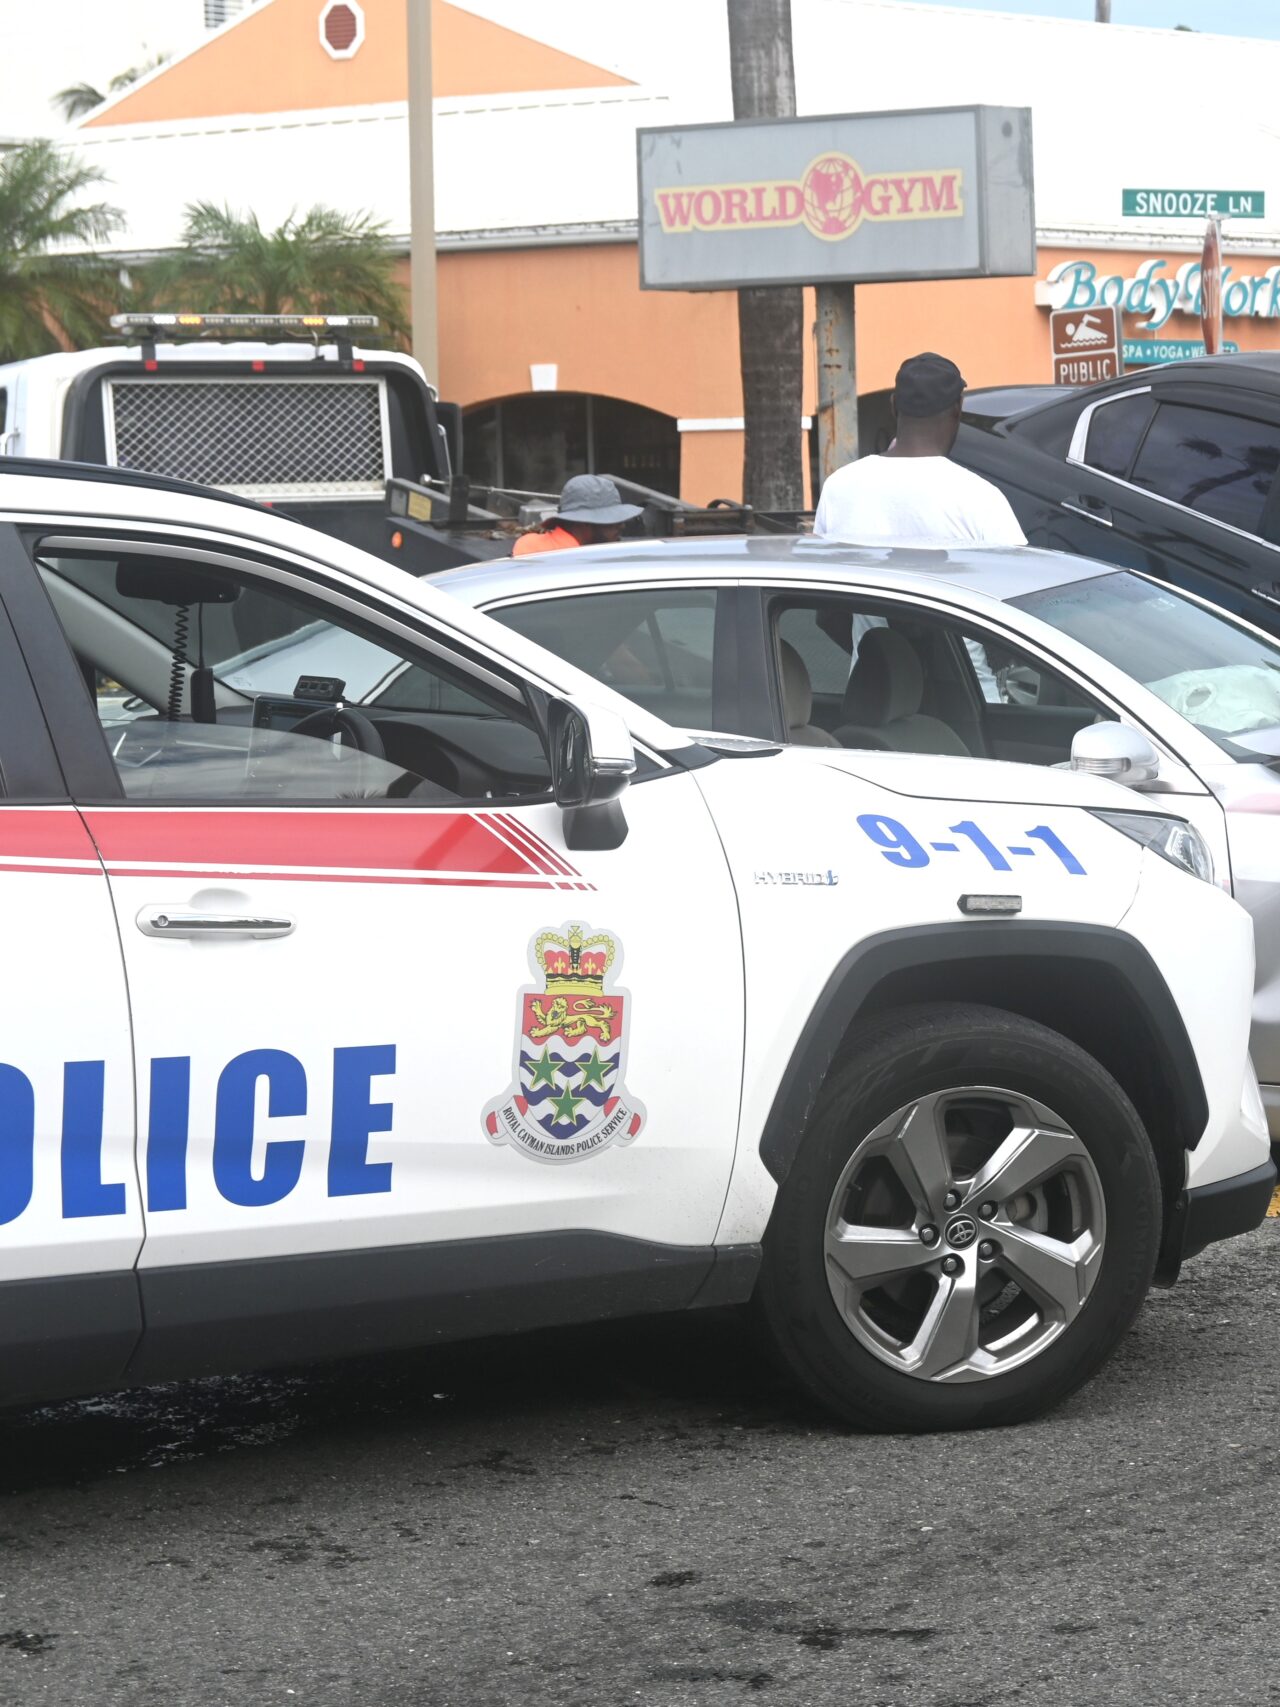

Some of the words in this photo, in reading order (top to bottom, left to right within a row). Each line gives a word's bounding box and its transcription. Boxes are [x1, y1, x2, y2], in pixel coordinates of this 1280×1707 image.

[657, 184, 803, 228] WORLD
[862, 174, 959, 217] GYM
[1135, 191, 1218, 215] SNOOZE
[1228, 196, 1252, 213] LN
[1122, 344, 1143, 358] SPA
[1153, 344, 1184, 359] YOGA
[1060, 358, 1112, 385] PUBLIC
[856, 813, 1088, 876] 9-1-1
[754, 870, 823, 886] HYBRID
[502, 1106, 521, 1134] ROYAL
[517, 1128, 546, 1152] CAYMAN
[544, 1144, 575, 1156] ISLANDS
[576, 1136, 603, 1153] POLICE
[603, 1107, 628, 1139] SERVICE
